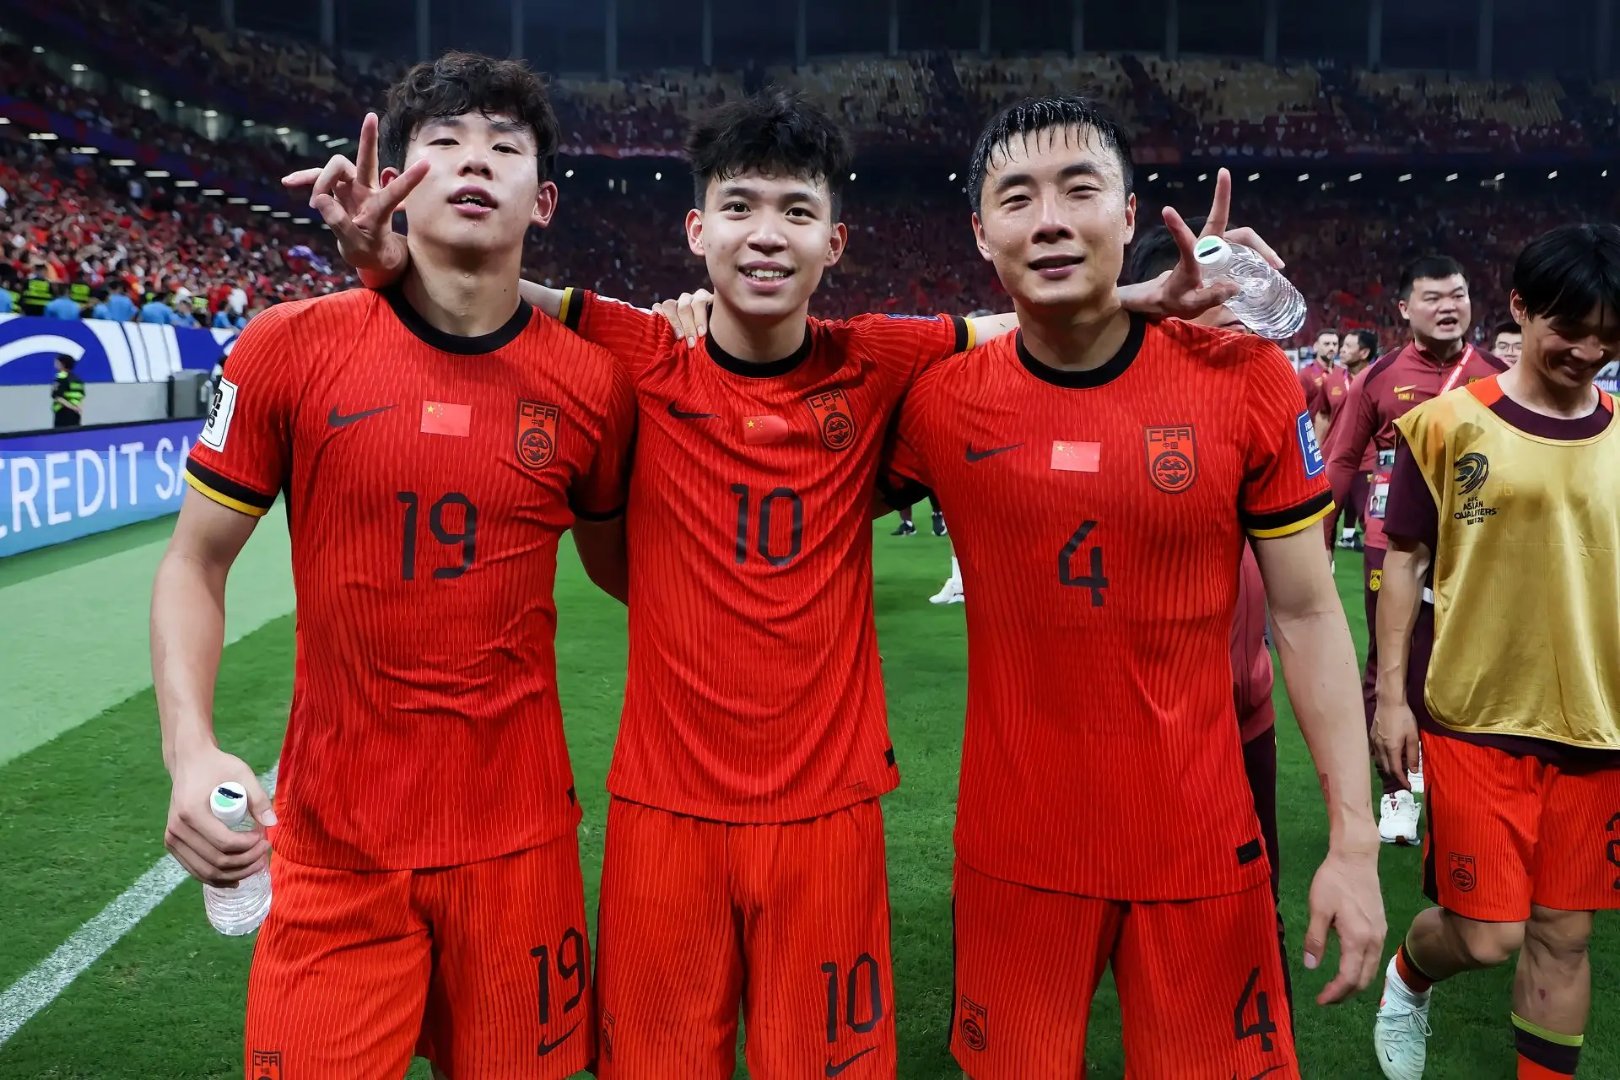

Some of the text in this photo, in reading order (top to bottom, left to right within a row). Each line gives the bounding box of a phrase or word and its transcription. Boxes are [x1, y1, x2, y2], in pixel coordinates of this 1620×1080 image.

[521, 403, 556, 421] CFA
[810, 389, 843, 408] CFA
[1149, 429, 1190, 442] CFA
[396, 491, 477, 581] 19
[730, 483, 803, 567] 10
[1463, 501, 1484, 510] ASIAN
[1058, 520, 1109, 607] 4
[530, 927, 586, 1025] 19
[821, 952, 883, 1043] 10
[1234, 966, 1277, 1052] 4
[254, 1055, 278, 1067] CFA
